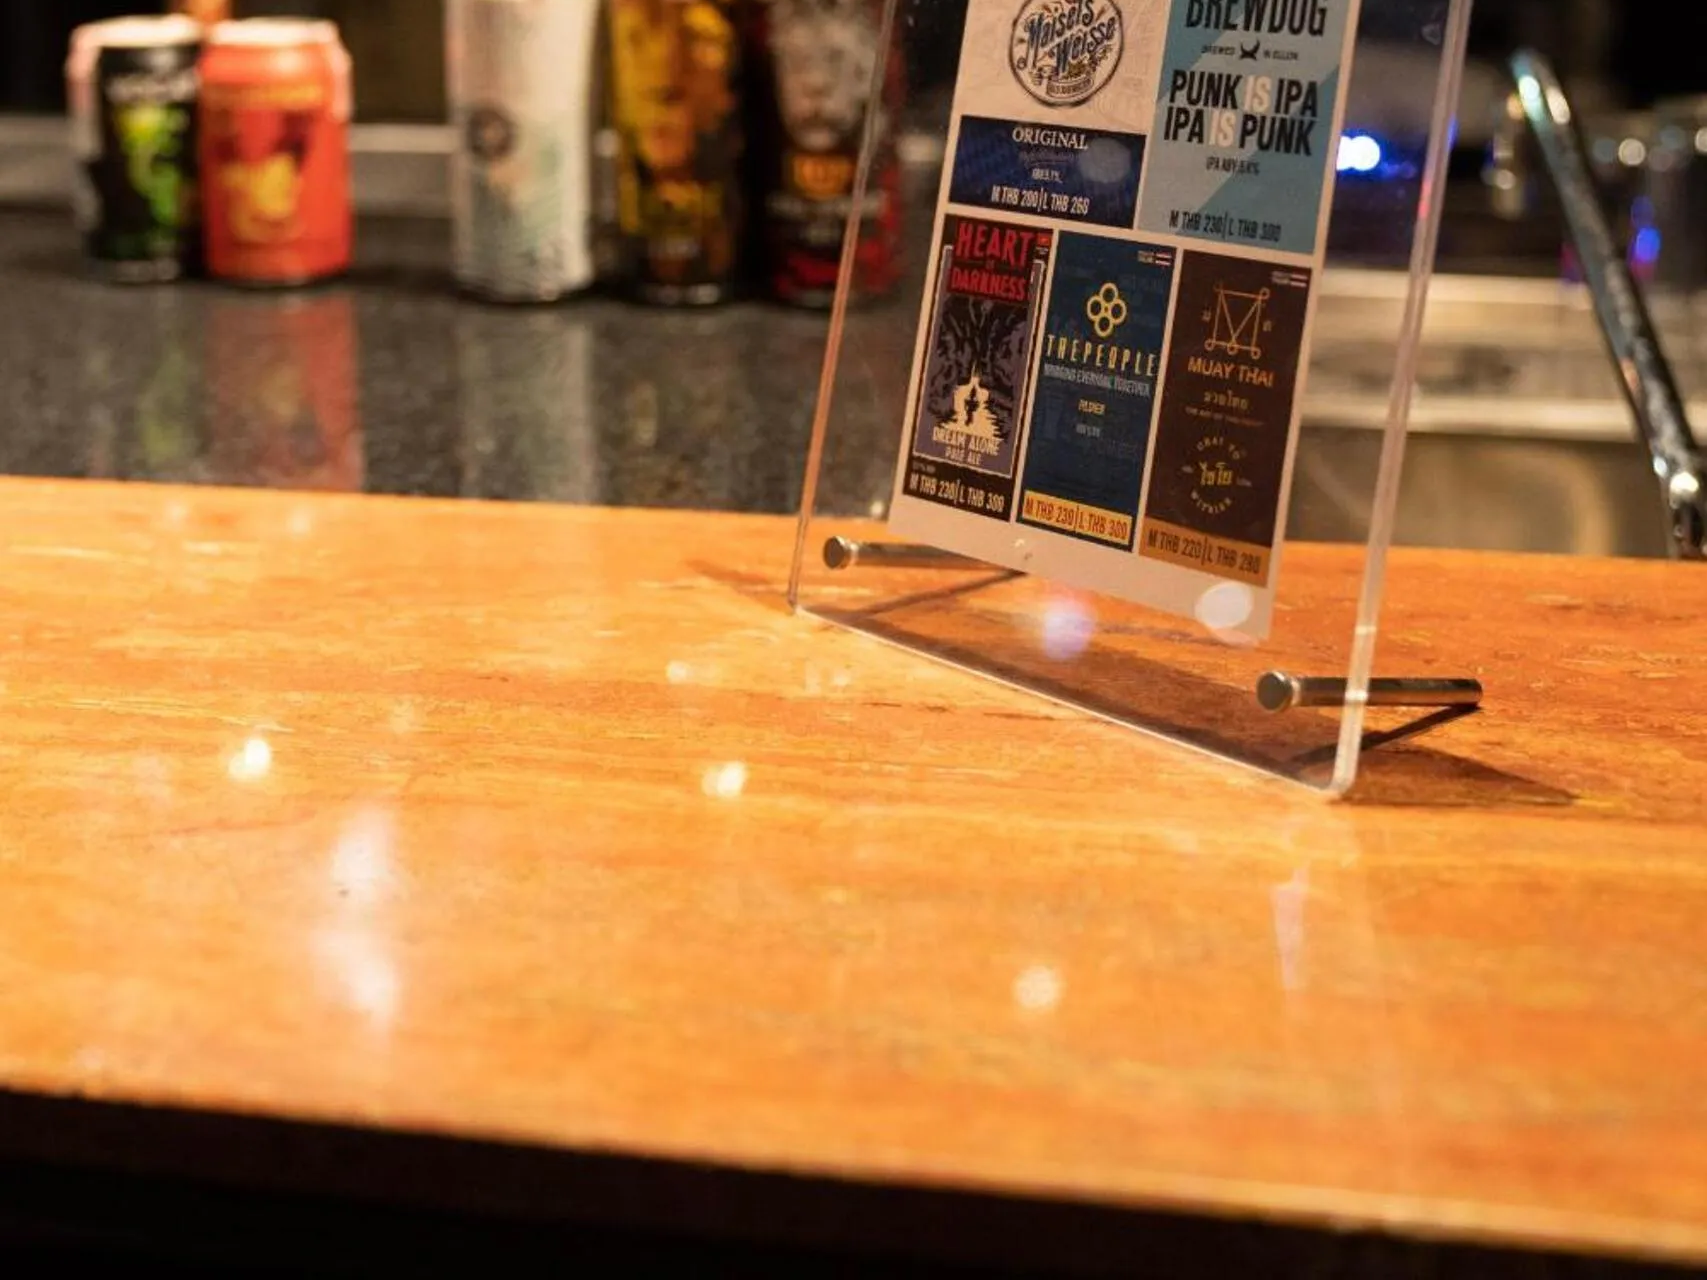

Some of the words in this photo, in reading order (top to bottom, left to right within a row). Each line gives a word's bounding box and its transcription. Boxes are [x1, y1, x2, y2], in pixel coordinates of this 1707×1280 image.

[1050, 17, 1117, 78] Weisse
[1169, 69, 1243, 110] PUNK
[1244, 74, 1273, 113] IS
[1275, 78, 1319, 118] IPA
[1012, 126, 1089, 150] ORIGINAL
[1164, 106, 1205, 144] IPA
[1208, 109, 1237, 148] IS
[1238, 113, 1317, 157] PUNK
[991, 184, 1001, 202] M
[1001, 186, 1020, 206] THB
[1050, 193, 1070, 213] THB
[1169, 209, 1179, 229] M
[1181, 211, 1201, 232] THB
[1237, 218, 1259, 239] THB
[955, 222, 1035, 270] HEART
[951, 266, 1026, 301] DARKNESS
[1187, 355, 1235, 380] MUAY
[1237, 364, 1275, 388] THAI
[932, 426, 966, 450] DREAM
[967, 434, 1001, 457] ALONE
[909, 472, 919, 490] M
[919, 474, 938, 496] THB
[967, 486, 985, 508] THB
[1035, 499, 1054, 520] THB
[1087, 512, 1106, 534] THB
[1160, 531, 1180, 554] THB
[1217, 546, 1237, 568] THB
